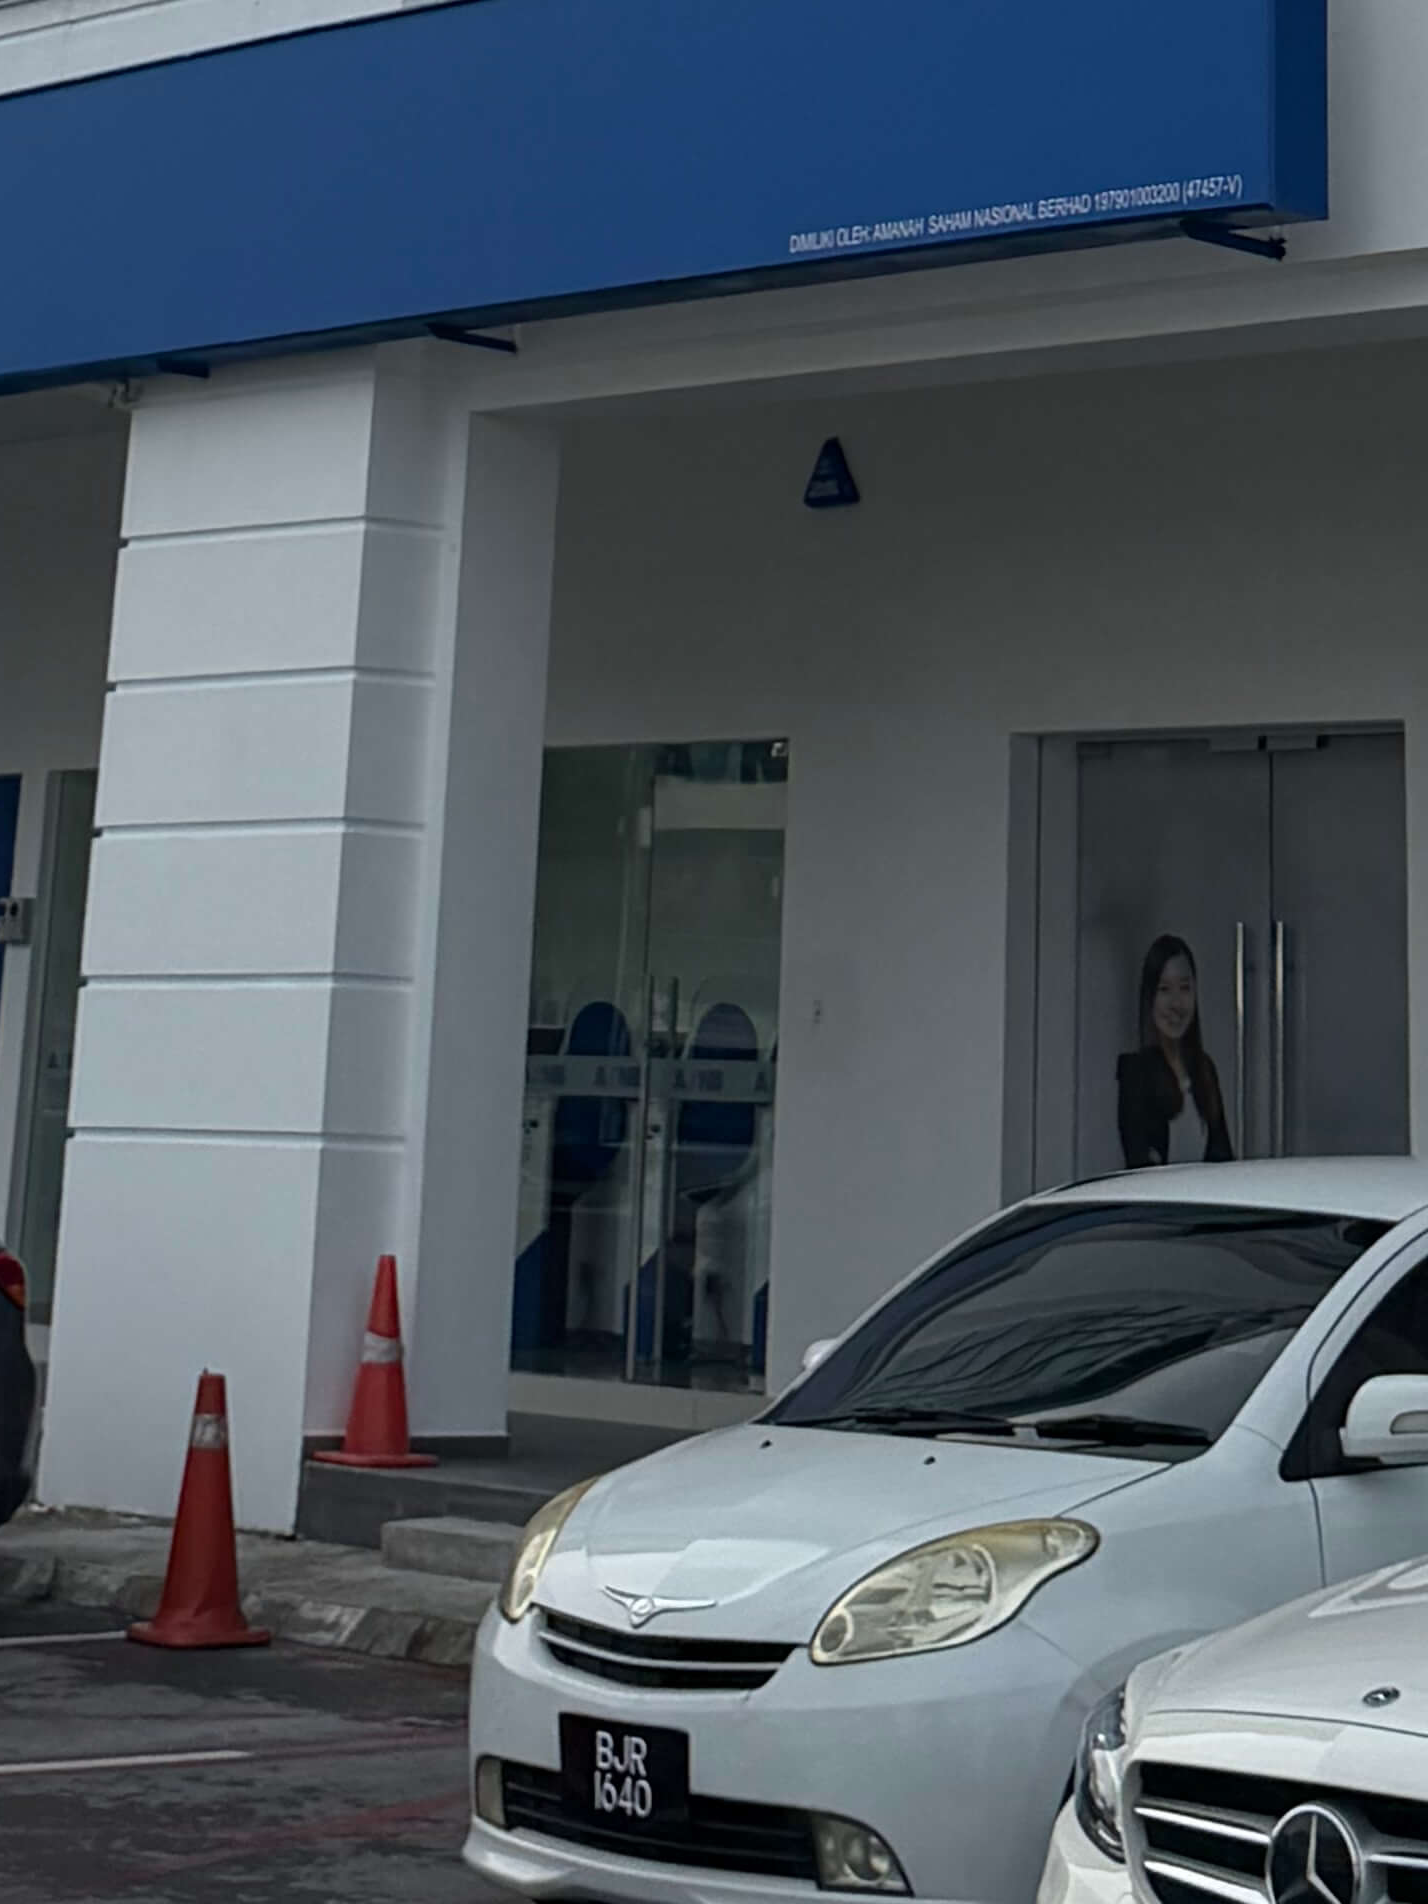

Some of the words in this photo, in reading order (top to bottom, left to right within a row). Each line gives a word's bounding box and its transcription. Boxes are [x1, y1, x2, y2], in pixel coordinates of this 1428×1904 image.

[872, 217, 925, 241] AMANAH
[927, 211, 972, 235] SAHAM
[973, 200, 1037, 228] NASIONAL
[1038, 193, 1092, 220] BERHAD
[596, 1730, 648, 1777] BJR
[594, 1770, 653, 1818] 1640
